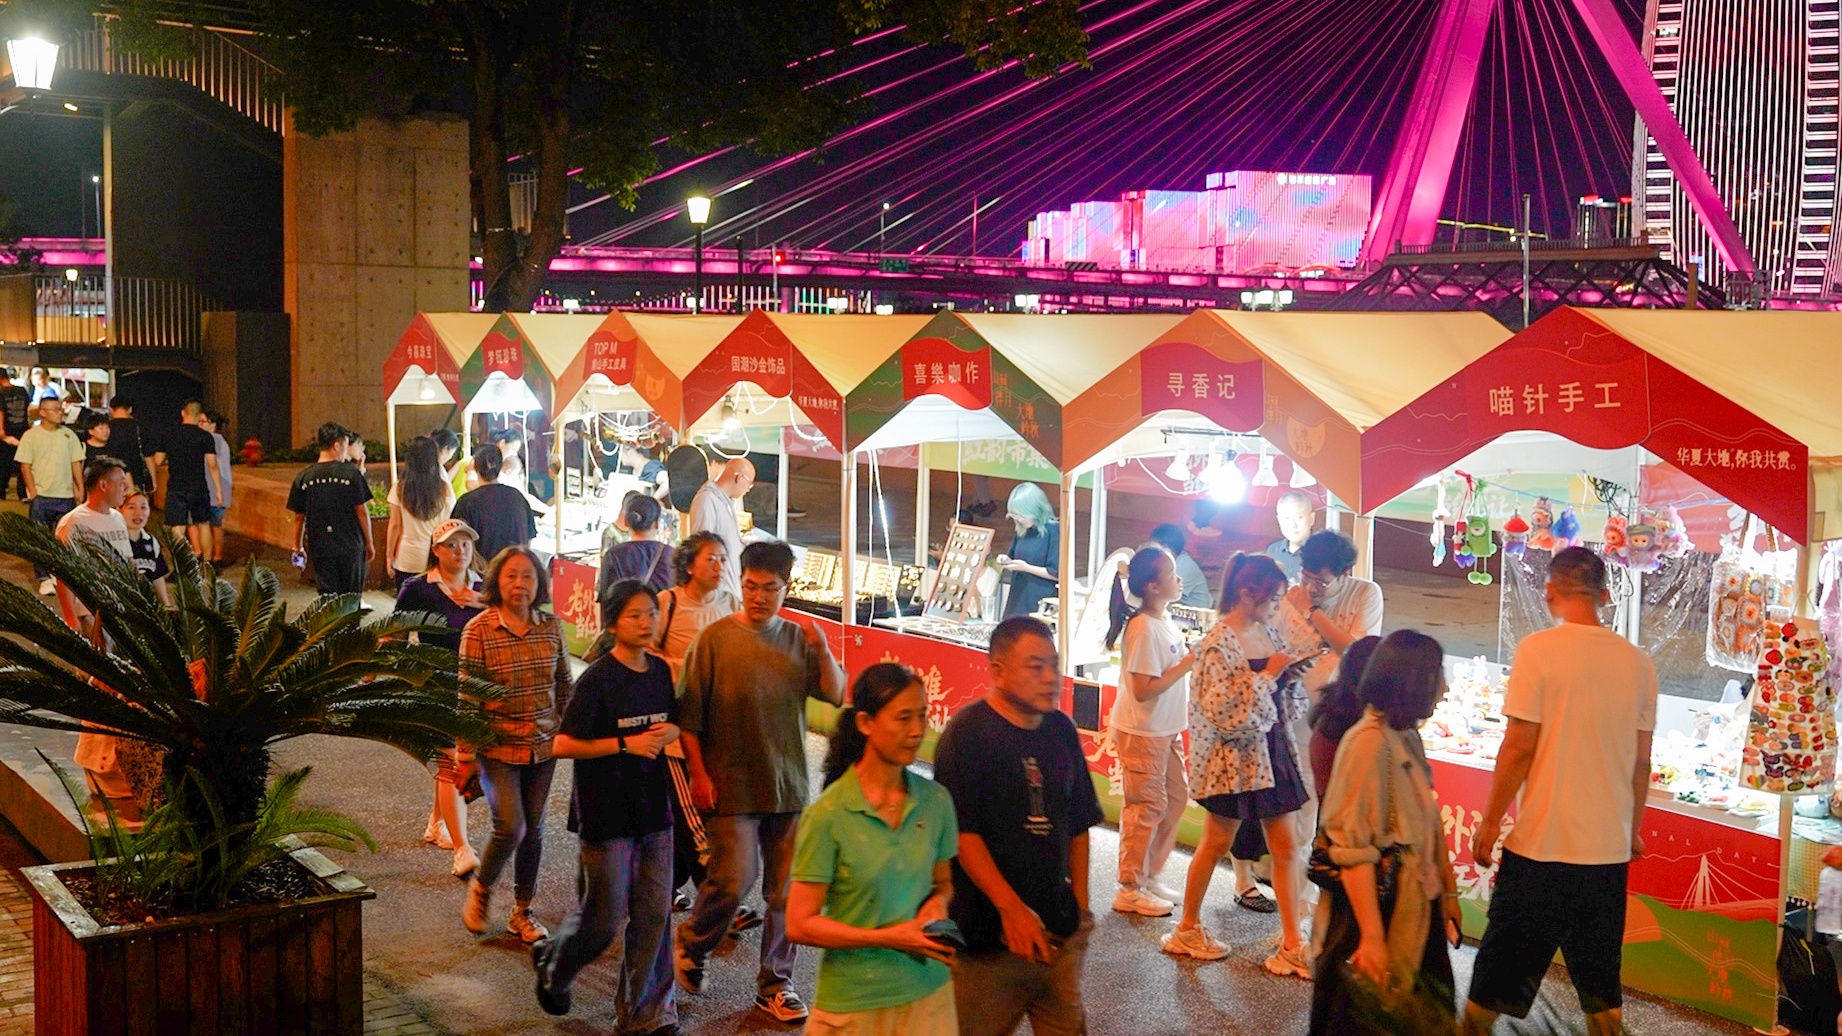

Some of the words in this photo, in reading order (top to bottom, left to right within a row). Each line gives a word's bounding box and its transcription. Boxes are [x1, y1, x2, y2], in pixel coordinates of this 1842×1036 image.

[594, 342, 609, 355] TOP
[609, 341, 618, 354] M
[731, 355, 786, 375] 国潮沙金饰品
[914, 361, 979, 385] 喜樂咖作
[1167, 372, 1236, 400] 寻香记
[1489, 381, 1622, 417] 喵针手工
[617, 715, 650, 729] MISTY
[1716, 846, 1757, 863] DAY
